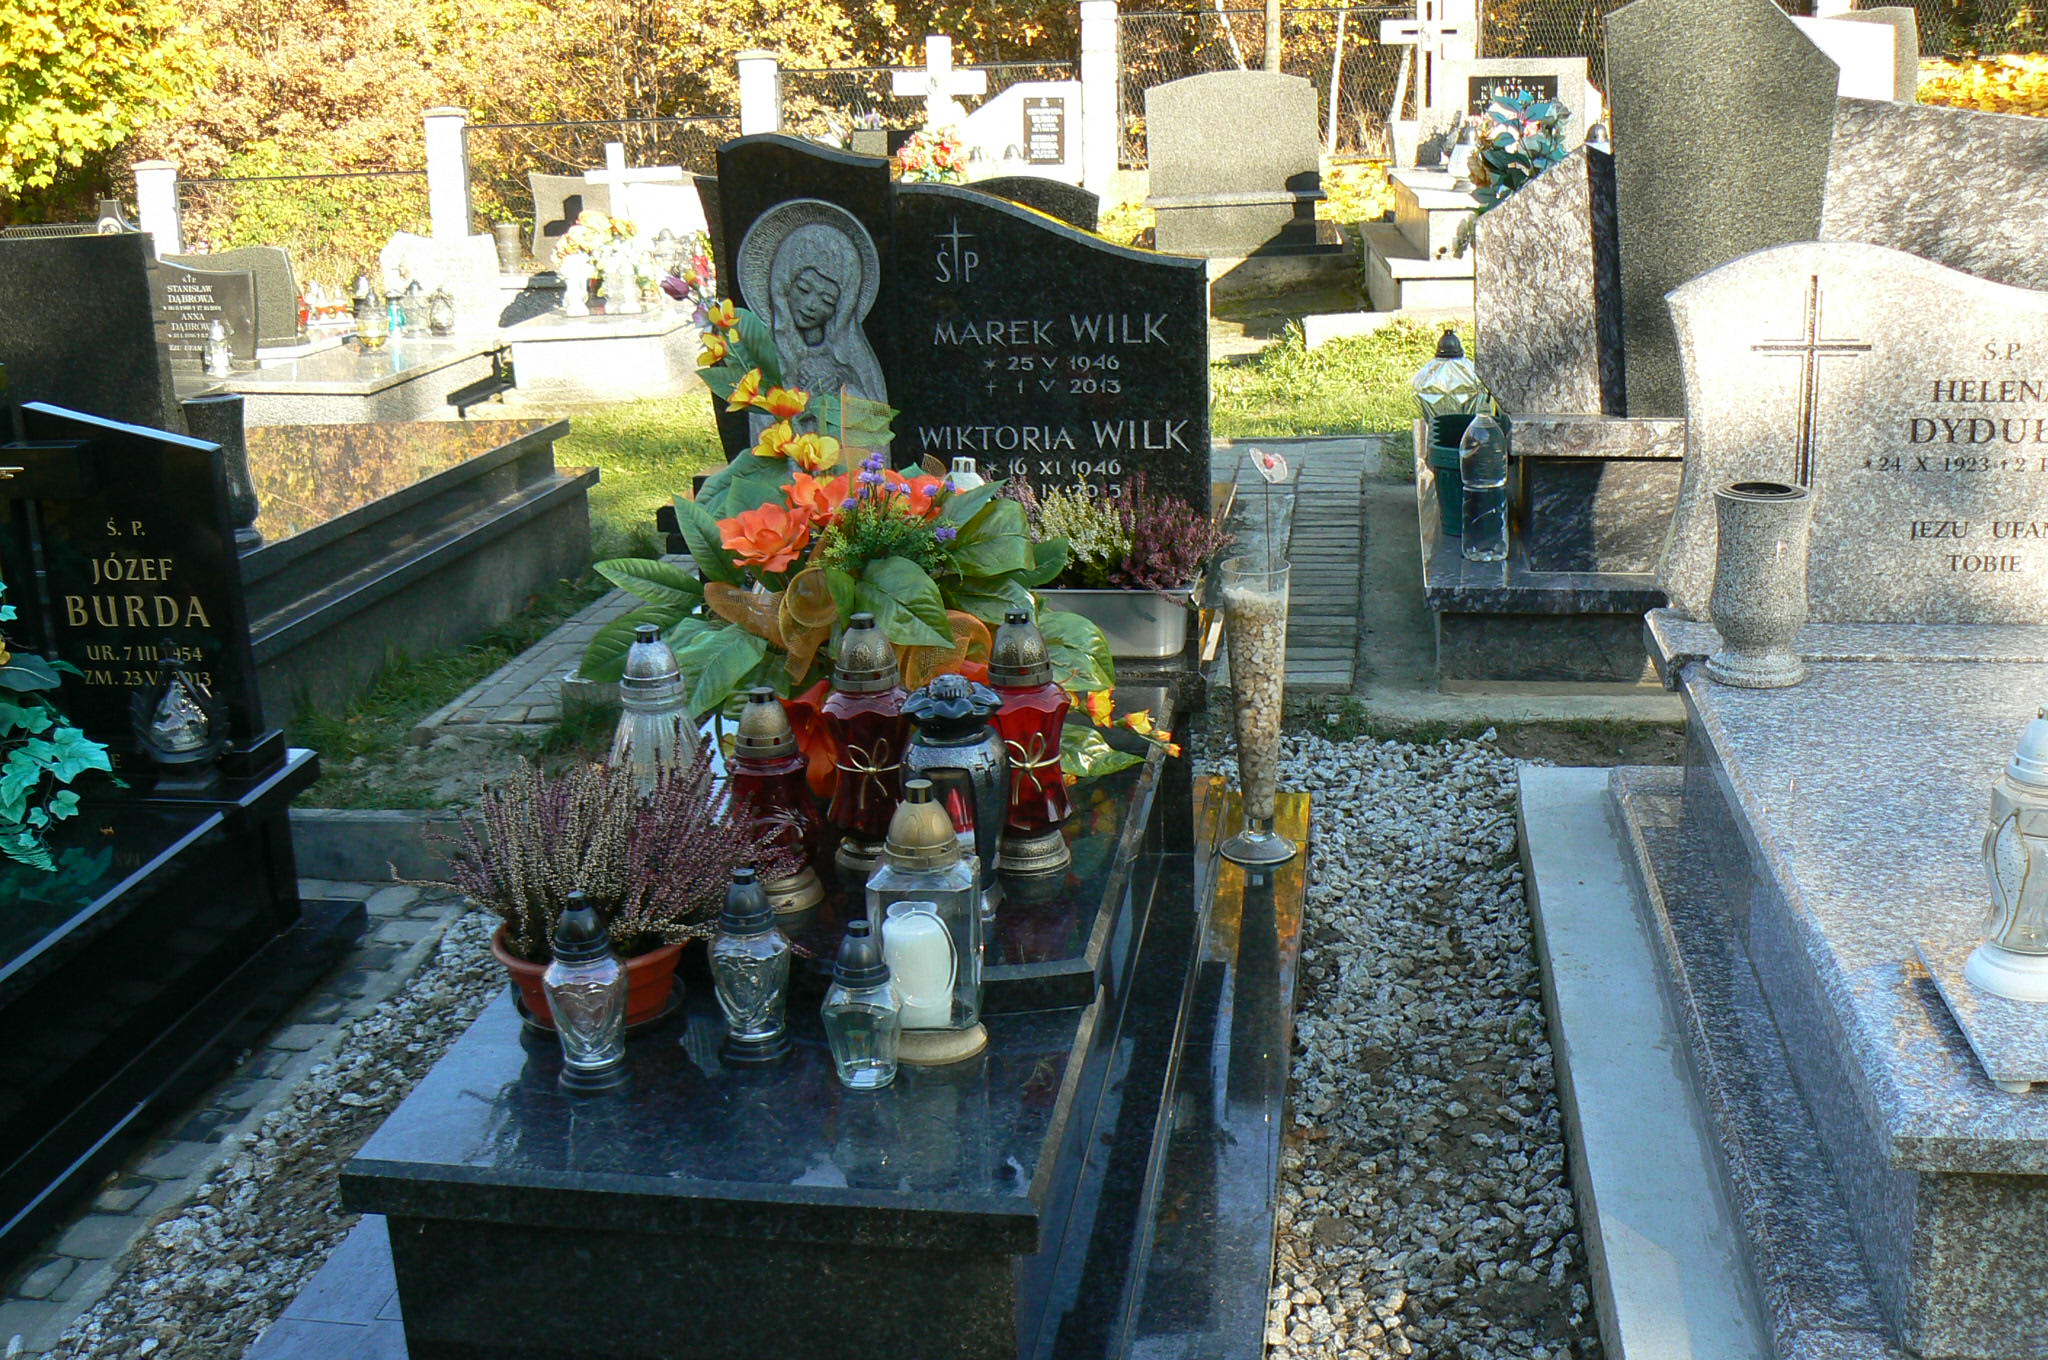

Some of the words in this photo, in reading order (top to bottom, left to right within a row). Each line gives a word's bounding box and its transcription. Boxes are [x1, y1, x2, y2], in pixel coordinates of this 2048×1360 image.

[171, 322, 210, 332] DĄBROW
[933, 320, 1056, 347] MAREK
[1070, 312, 1169, 346] WILK
[1007, 356, 1034, 371] 25
[1041, 357, 1058, 371] V
[1069, 354, 1120, 373] 1946
[1038, 379, 1054, 393] V
[1069, 378, 1121, 394] 2013
[1931, 379, 2048, 403] HELEN
[918, 425, 1076, 453] WIKTORIA
[1091, 419, 1192, 454] WILK
[1008, 457, 1028, 475] 16
[1039, 461, 1061, 475] XI
[1070, 458, 1122, 477] 1946
[1879, 456, 1901, 472] 24
[1914, 456, 1934, 473] X
[1944, 456, 1989, 473] 1923
[1910, 521, 1970, 541] JEZU
[92, 552, 173, 584] JÓZEF
[1946, 554, 2023, 573] TOBIE
[65, 595, 211, 628] BURDA
[86, 645, 120, 661] UR.
[123, 646, 133, 661] 7
[84, 669, 119, 686] ZM.
[123, 670, 143, 686] 23
